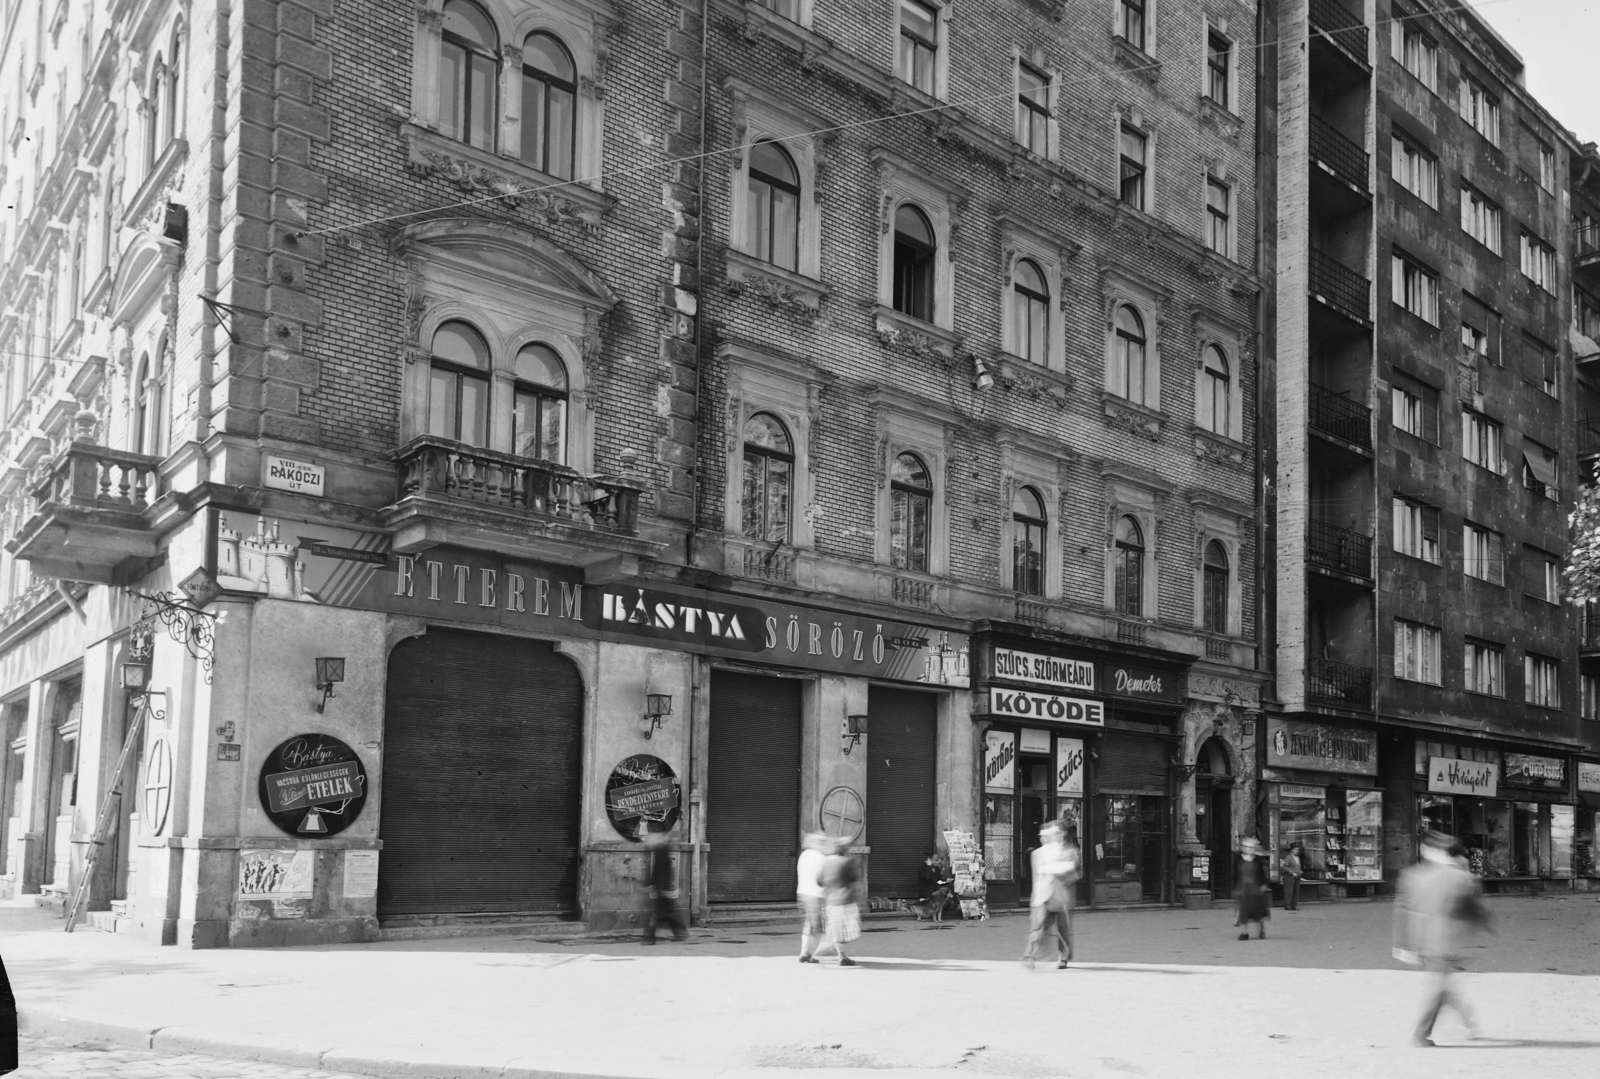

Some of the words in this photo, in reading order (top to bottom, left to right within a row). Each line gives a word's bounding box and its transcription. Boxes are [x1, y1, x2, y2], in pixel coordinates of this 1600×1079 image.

[270, 465, 320, 486] RÁKÓCZI
[289, 481, 302, 490] ÚT
[395, 551, 584, 622] ÉTTEREM
[602, 589, 747, 641] BÁSTYA
[765, 614, 887, 665] SÖRÖZŐ
[893, 637, 921, 650] 806
[996, 650, 1029, 678] SZŰCS
[1034, 656, 1092, 687] SZŐRMEÁRU
[1114, 669, 1164, 697] Demeter
[995, 692, 1101, 723] KÖTŐDE
[282, 738, 337, 771] Bástya
[986, 741, 1014, 785] KÖTŐDE
[1058, 749, 1083, 788] SZŰCS
[276, 775, 300, 787] VACSORA
[306, 776, 354, 800] ÉTELEK
[1447, 761, 1492, 793] Virágért
